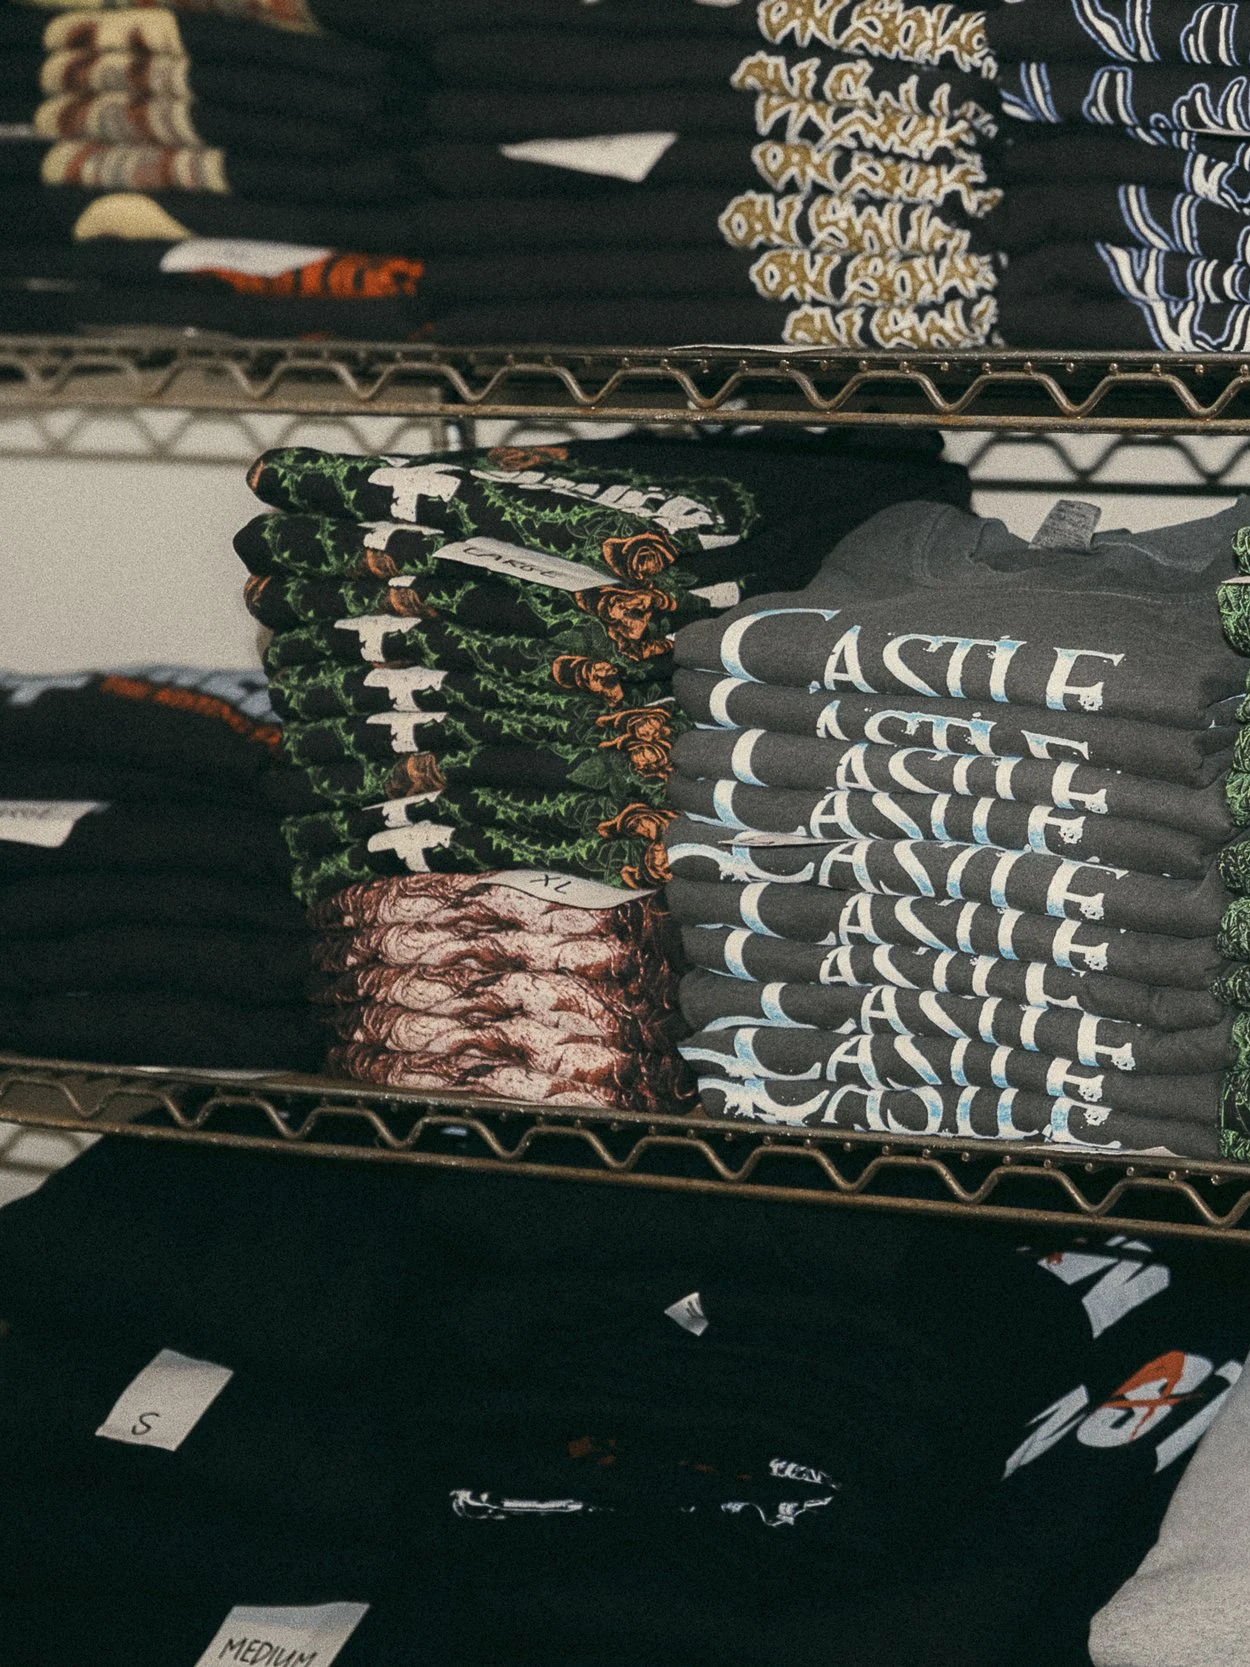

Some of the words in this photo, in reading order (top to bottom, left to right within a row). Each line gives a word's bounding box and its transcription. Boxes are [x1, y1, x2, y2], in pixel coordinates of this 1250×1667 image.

[530, 874, 572, 895] XL
[131, 1412, 161, 1436] S
[218, 1636, 319, 1667] MEDIUM
